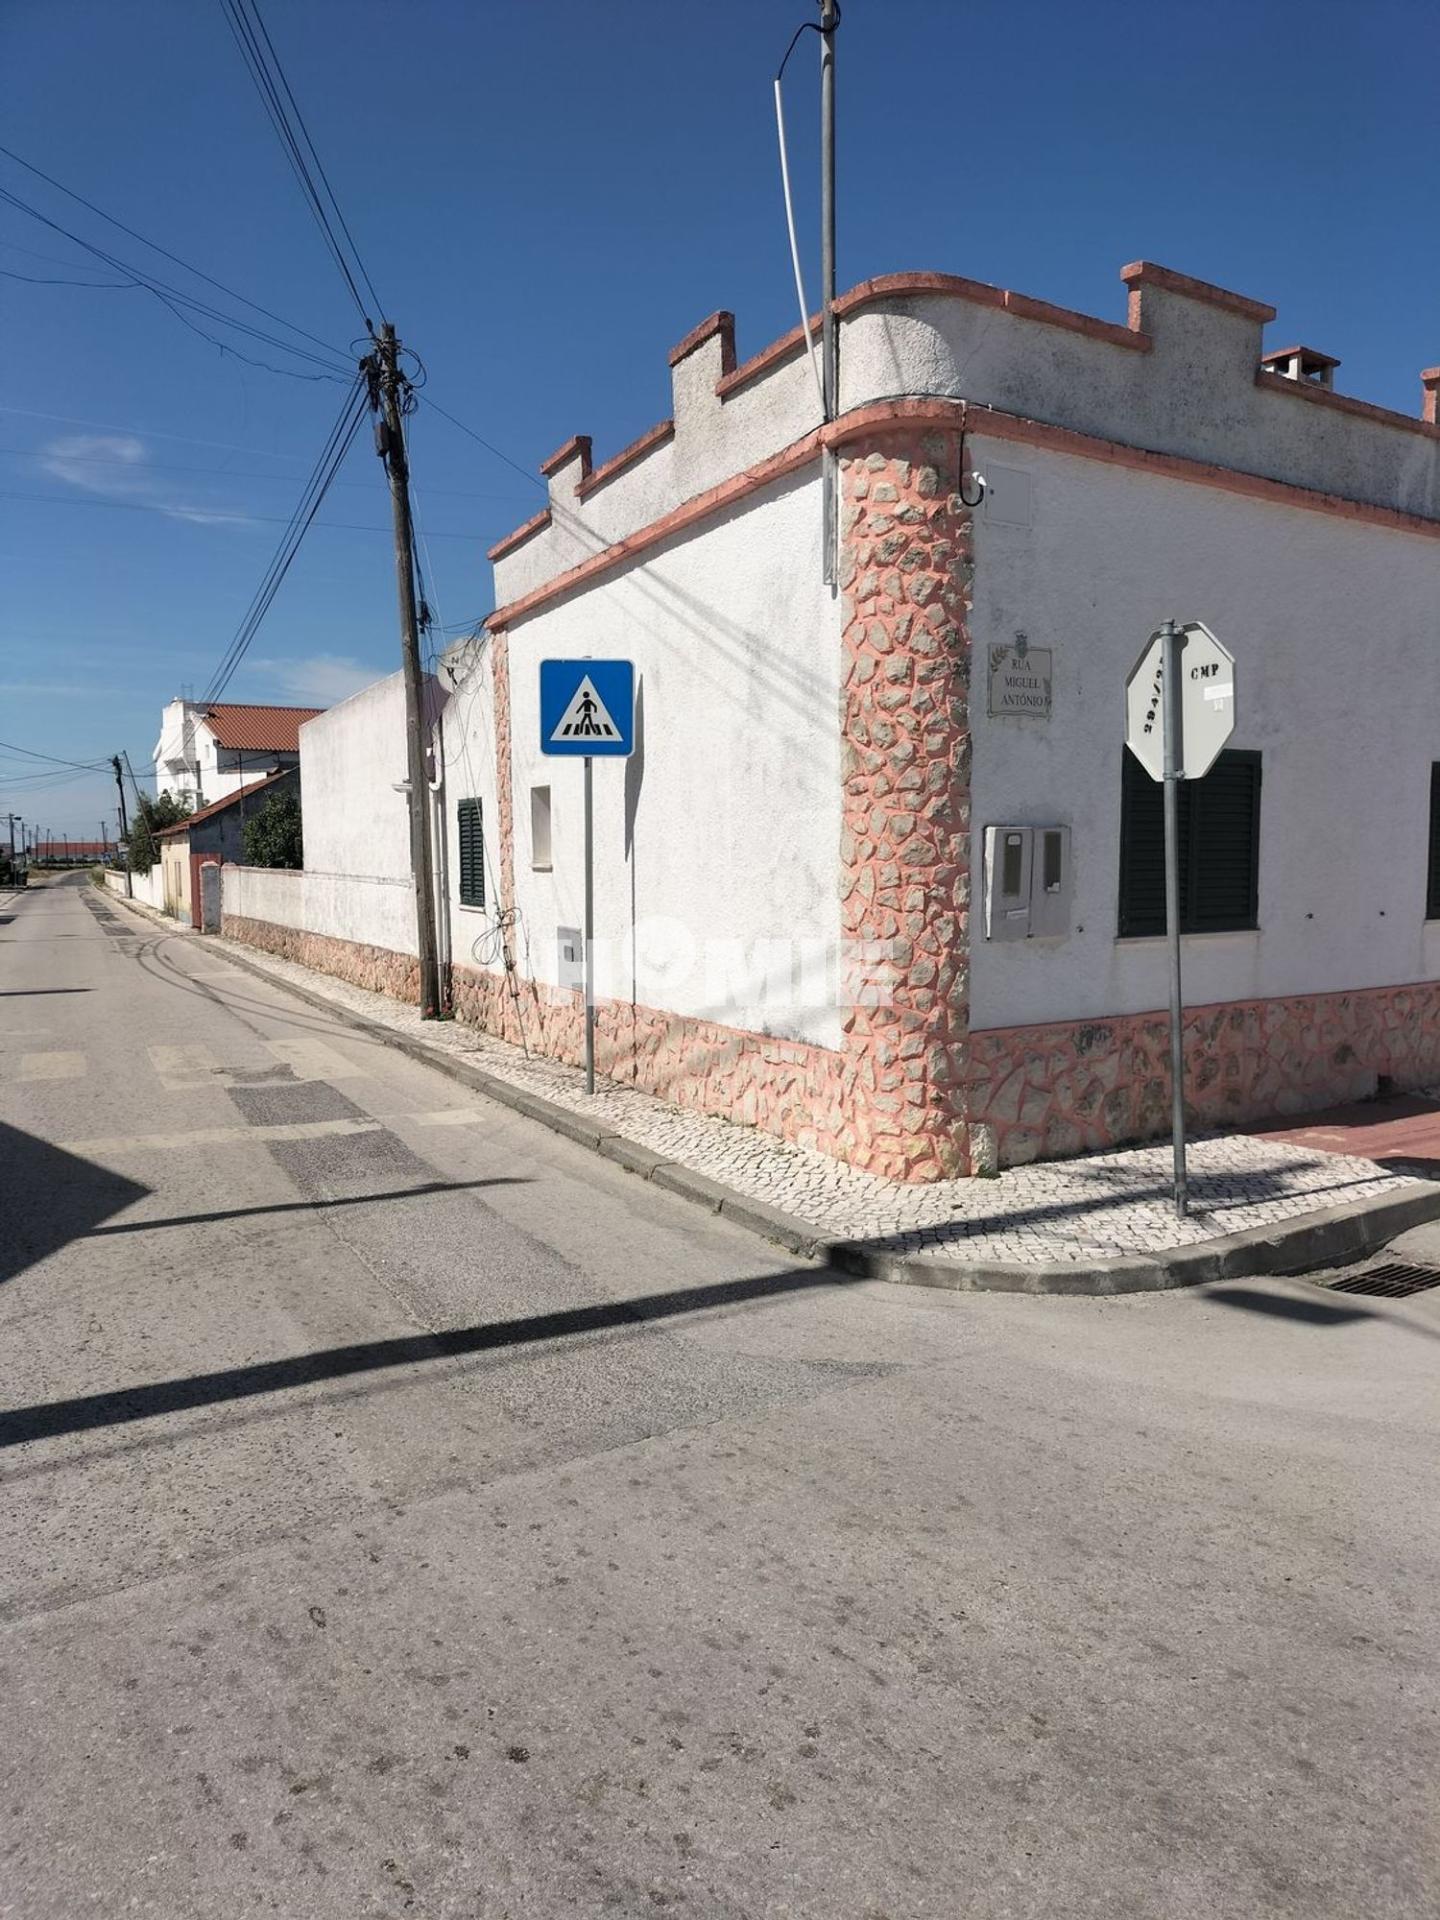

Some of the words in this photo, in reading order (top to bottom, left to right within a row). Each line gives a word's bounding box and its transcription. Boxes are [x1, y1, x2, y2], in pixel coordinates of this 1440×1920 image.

[1011, 658, 1031, 671] RUA
[1191, 663, 1219, 680] CMP
[1004, 676, 1040, 689] MIGUEL
[1001, 692, 1043, 706] ANTÓNIO
